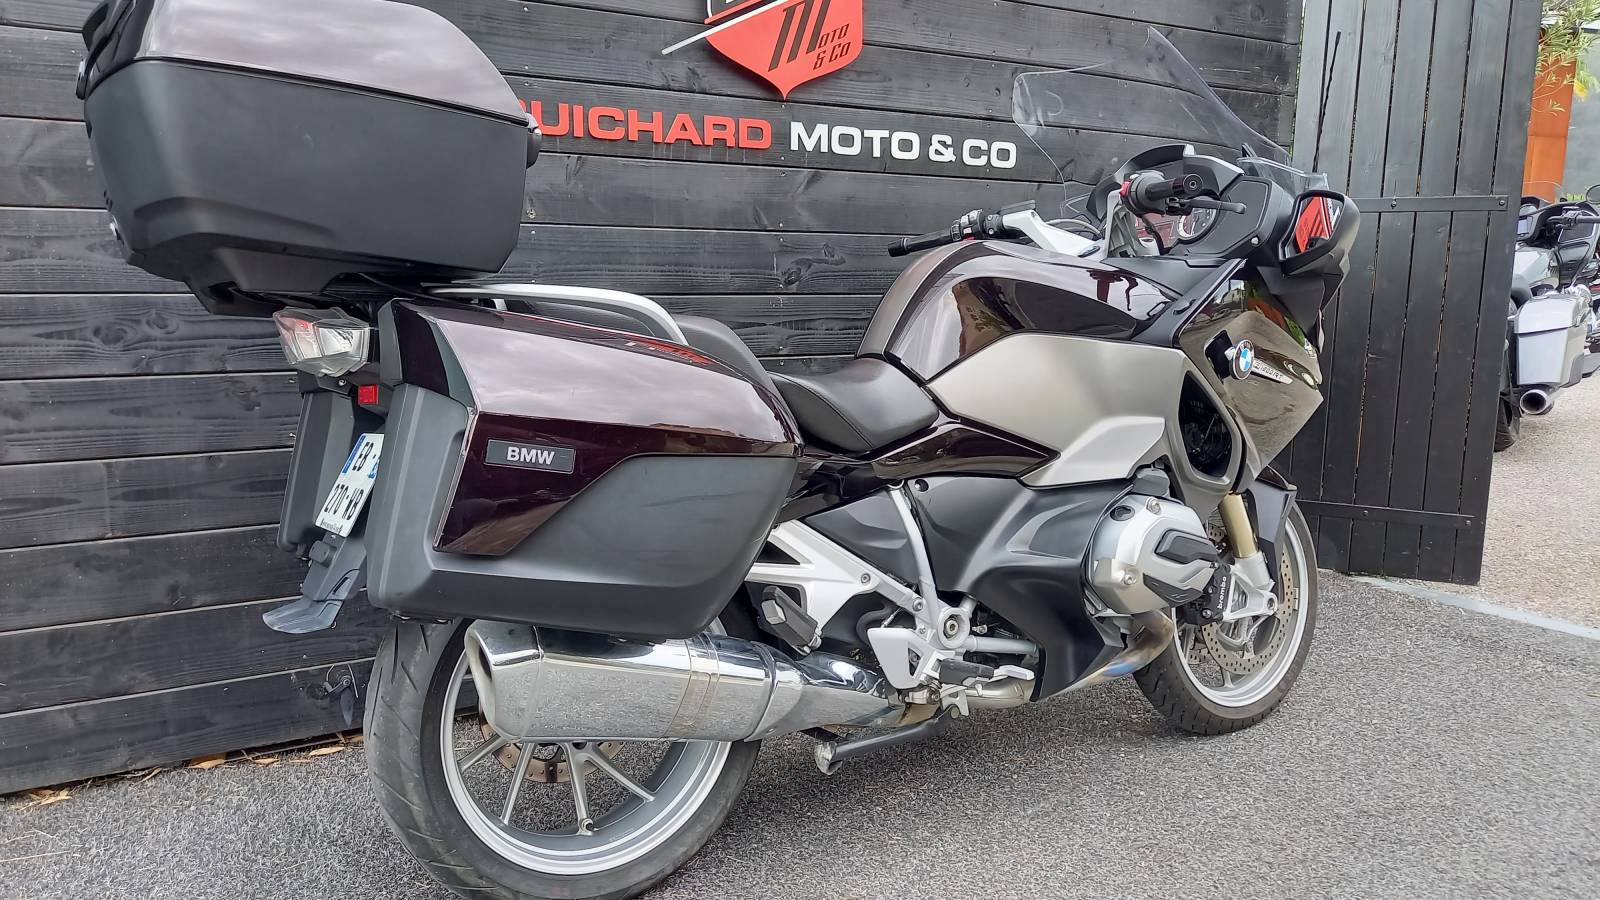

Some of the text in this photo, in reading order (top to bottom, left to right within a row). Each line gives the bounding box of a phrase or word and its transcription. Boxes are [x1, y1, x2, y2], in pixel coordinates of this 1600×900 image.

[519, 99, 772, 149] UICHARD
[790, 121, 921, 160] MOTO
[507, 446, 555, 465] BMW
[1217, 576, 1227, 609] brembo
